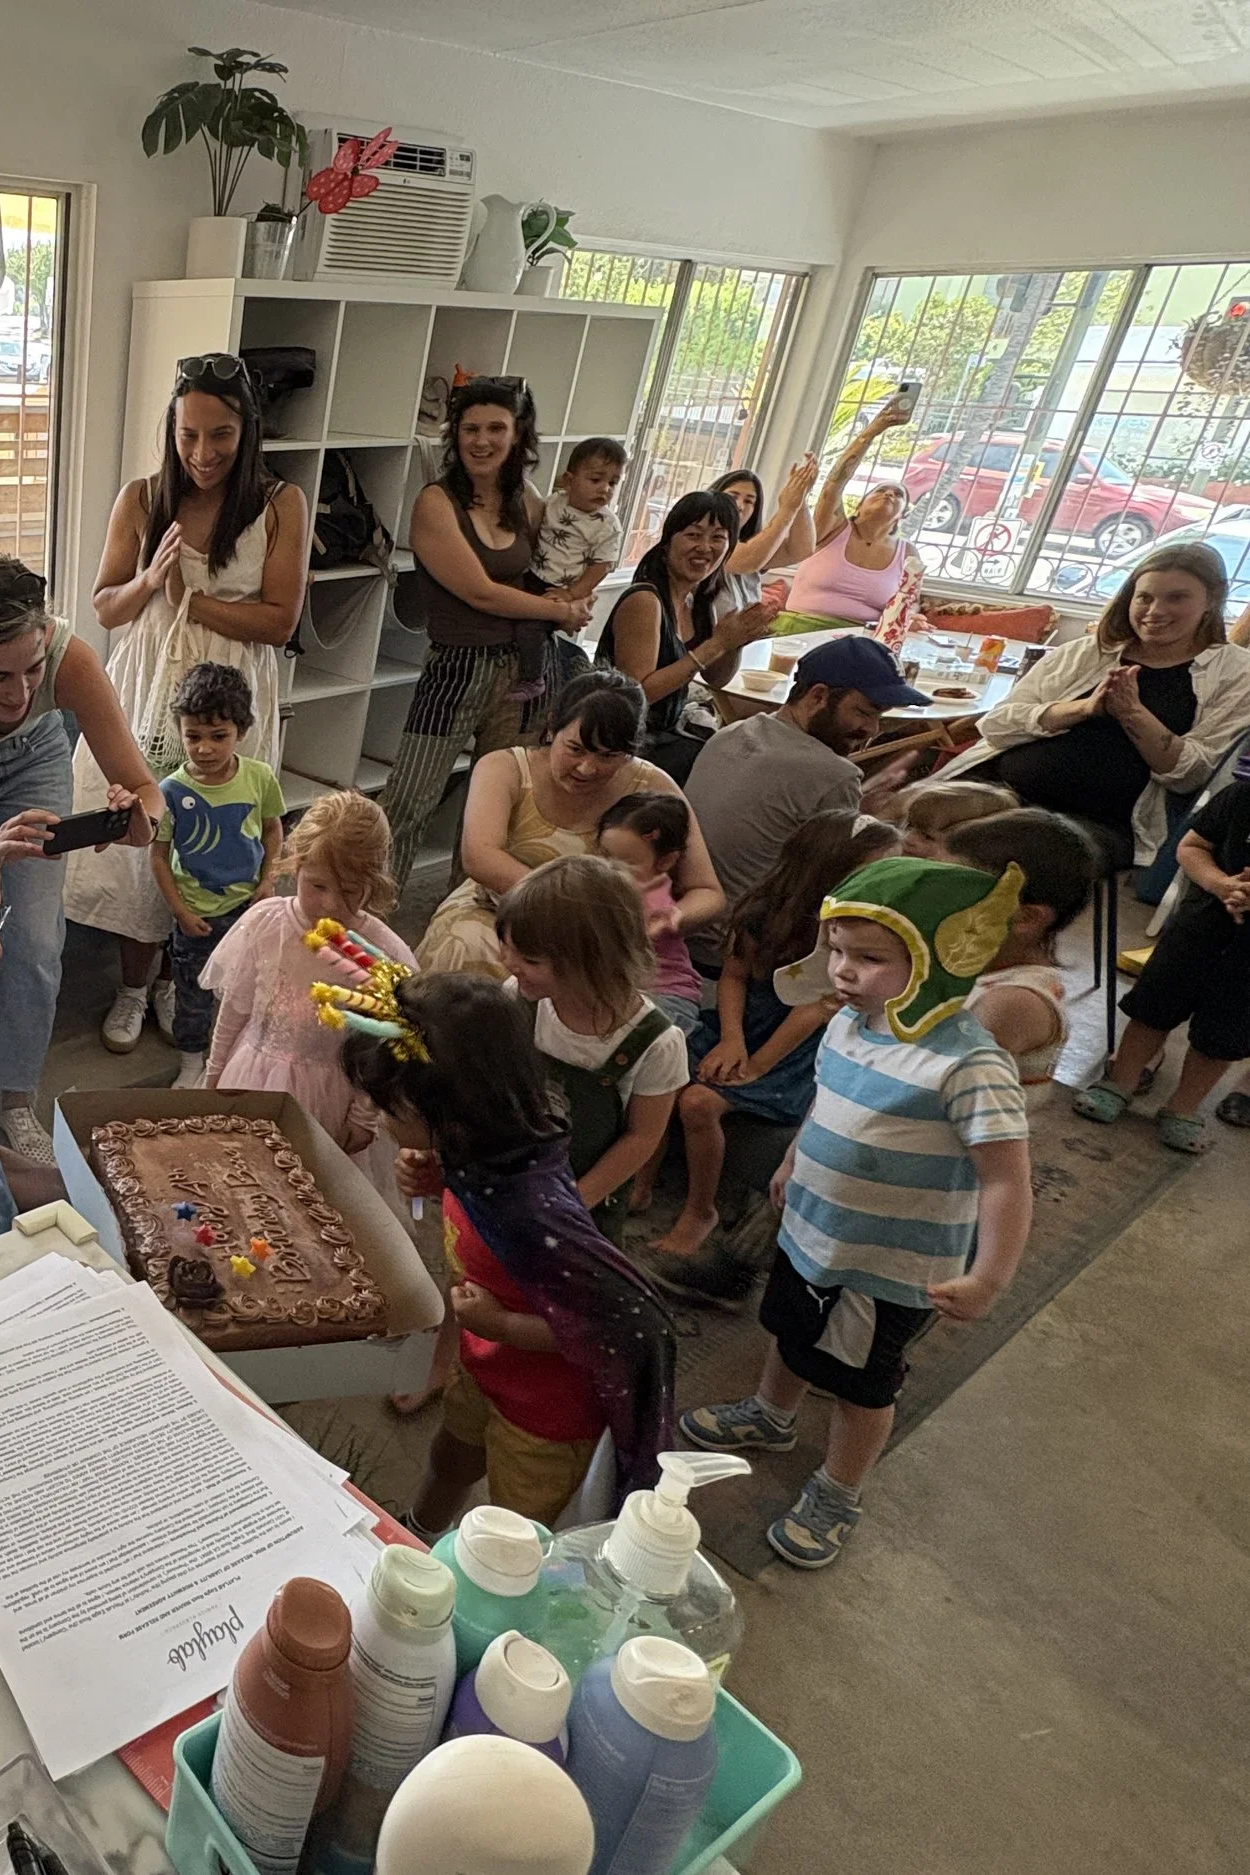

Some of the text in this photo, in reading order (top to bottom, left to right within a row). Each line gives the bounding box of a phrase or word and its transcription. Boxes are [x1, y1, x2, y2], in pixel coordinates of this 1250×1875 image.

[272, 1525, 304, 1545] ASSUMPTION
[229, 1552, 253, 1567] RELEASE
[166, 1582, 194, 1599] INDEMNITY
[134, 1595, 166, 1615] AGREEMENT
[170, 1599, 191, 1613] WAIVER
[158, 1610, 171, 1619] AND
[134, 1616, 159, 1632] RELEASE
[118, 1628, 134, 1640] FORM
[167, 1604, 244, 1671] playlab
